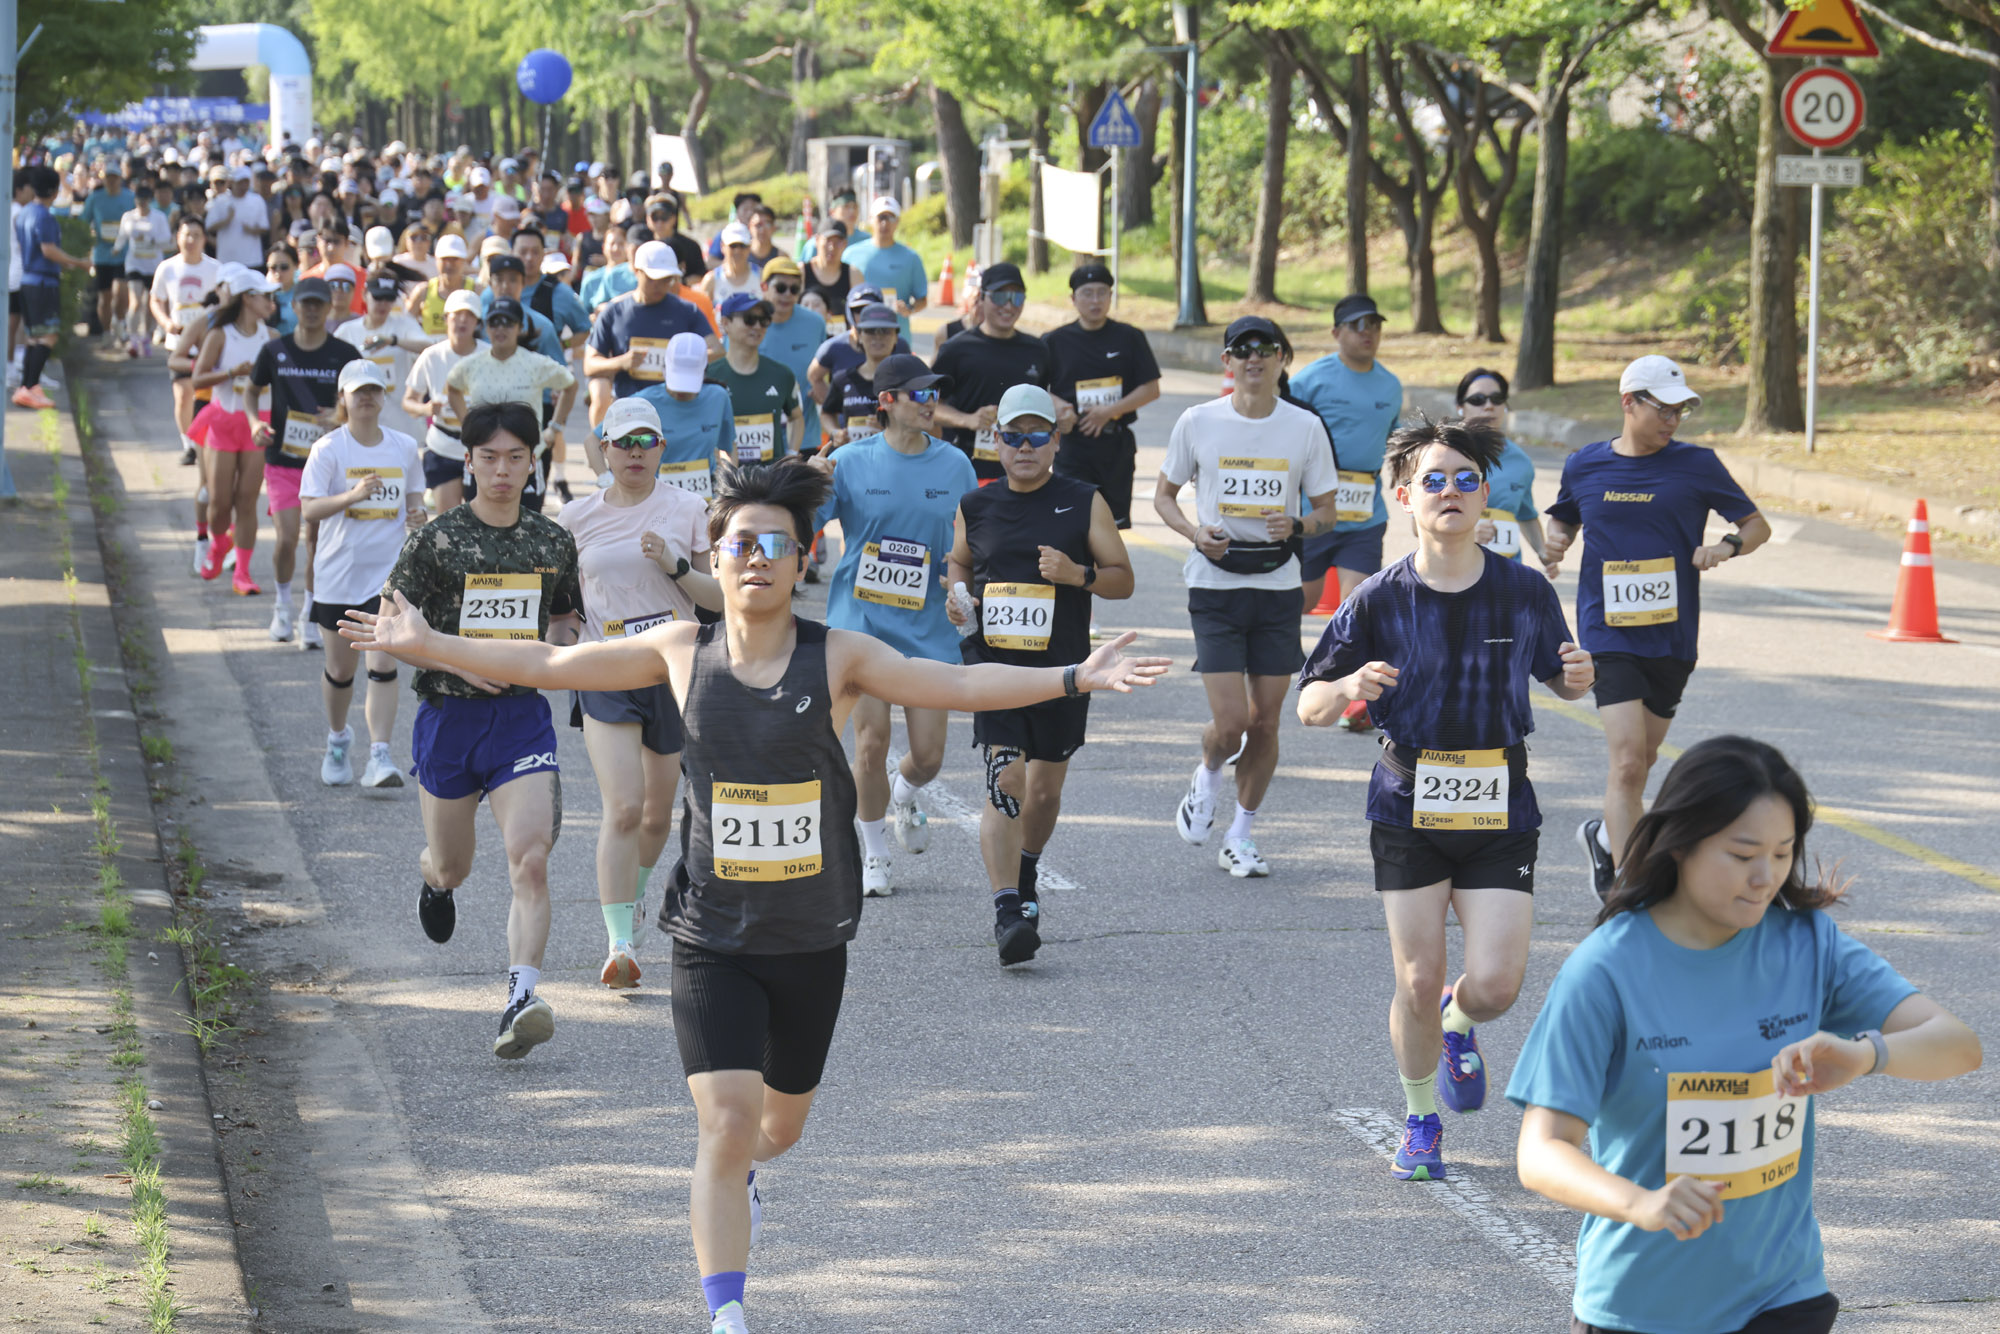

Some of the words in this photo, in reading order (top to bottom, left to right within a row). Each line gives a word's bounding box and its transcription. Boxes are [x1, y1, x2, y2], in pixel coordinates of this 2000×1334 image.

[1803, 91, 1845, 123] 20
[277, 367, 337, 377] HUMANRACE
[1223, 477, 1282, 497] 2139
[888, 542, 918, 555] 0269
[863, 563, 923, 589] 2002
[1611, 580, 1671, 603] 1082
[467, 599, 530, 619] 2351
[987, 605, 1047, 627] 2340
[1423, 751, 1465, 765] 시사저널
[720, 787, 768, 802] 시사저널
[1422, 776, 1501, 802] 2324
[722, 815, 812, 847] 2113
[1679, 1078, 1749, 1095] 시사저널
[1679, 1102, 1796, 1156] 2118
